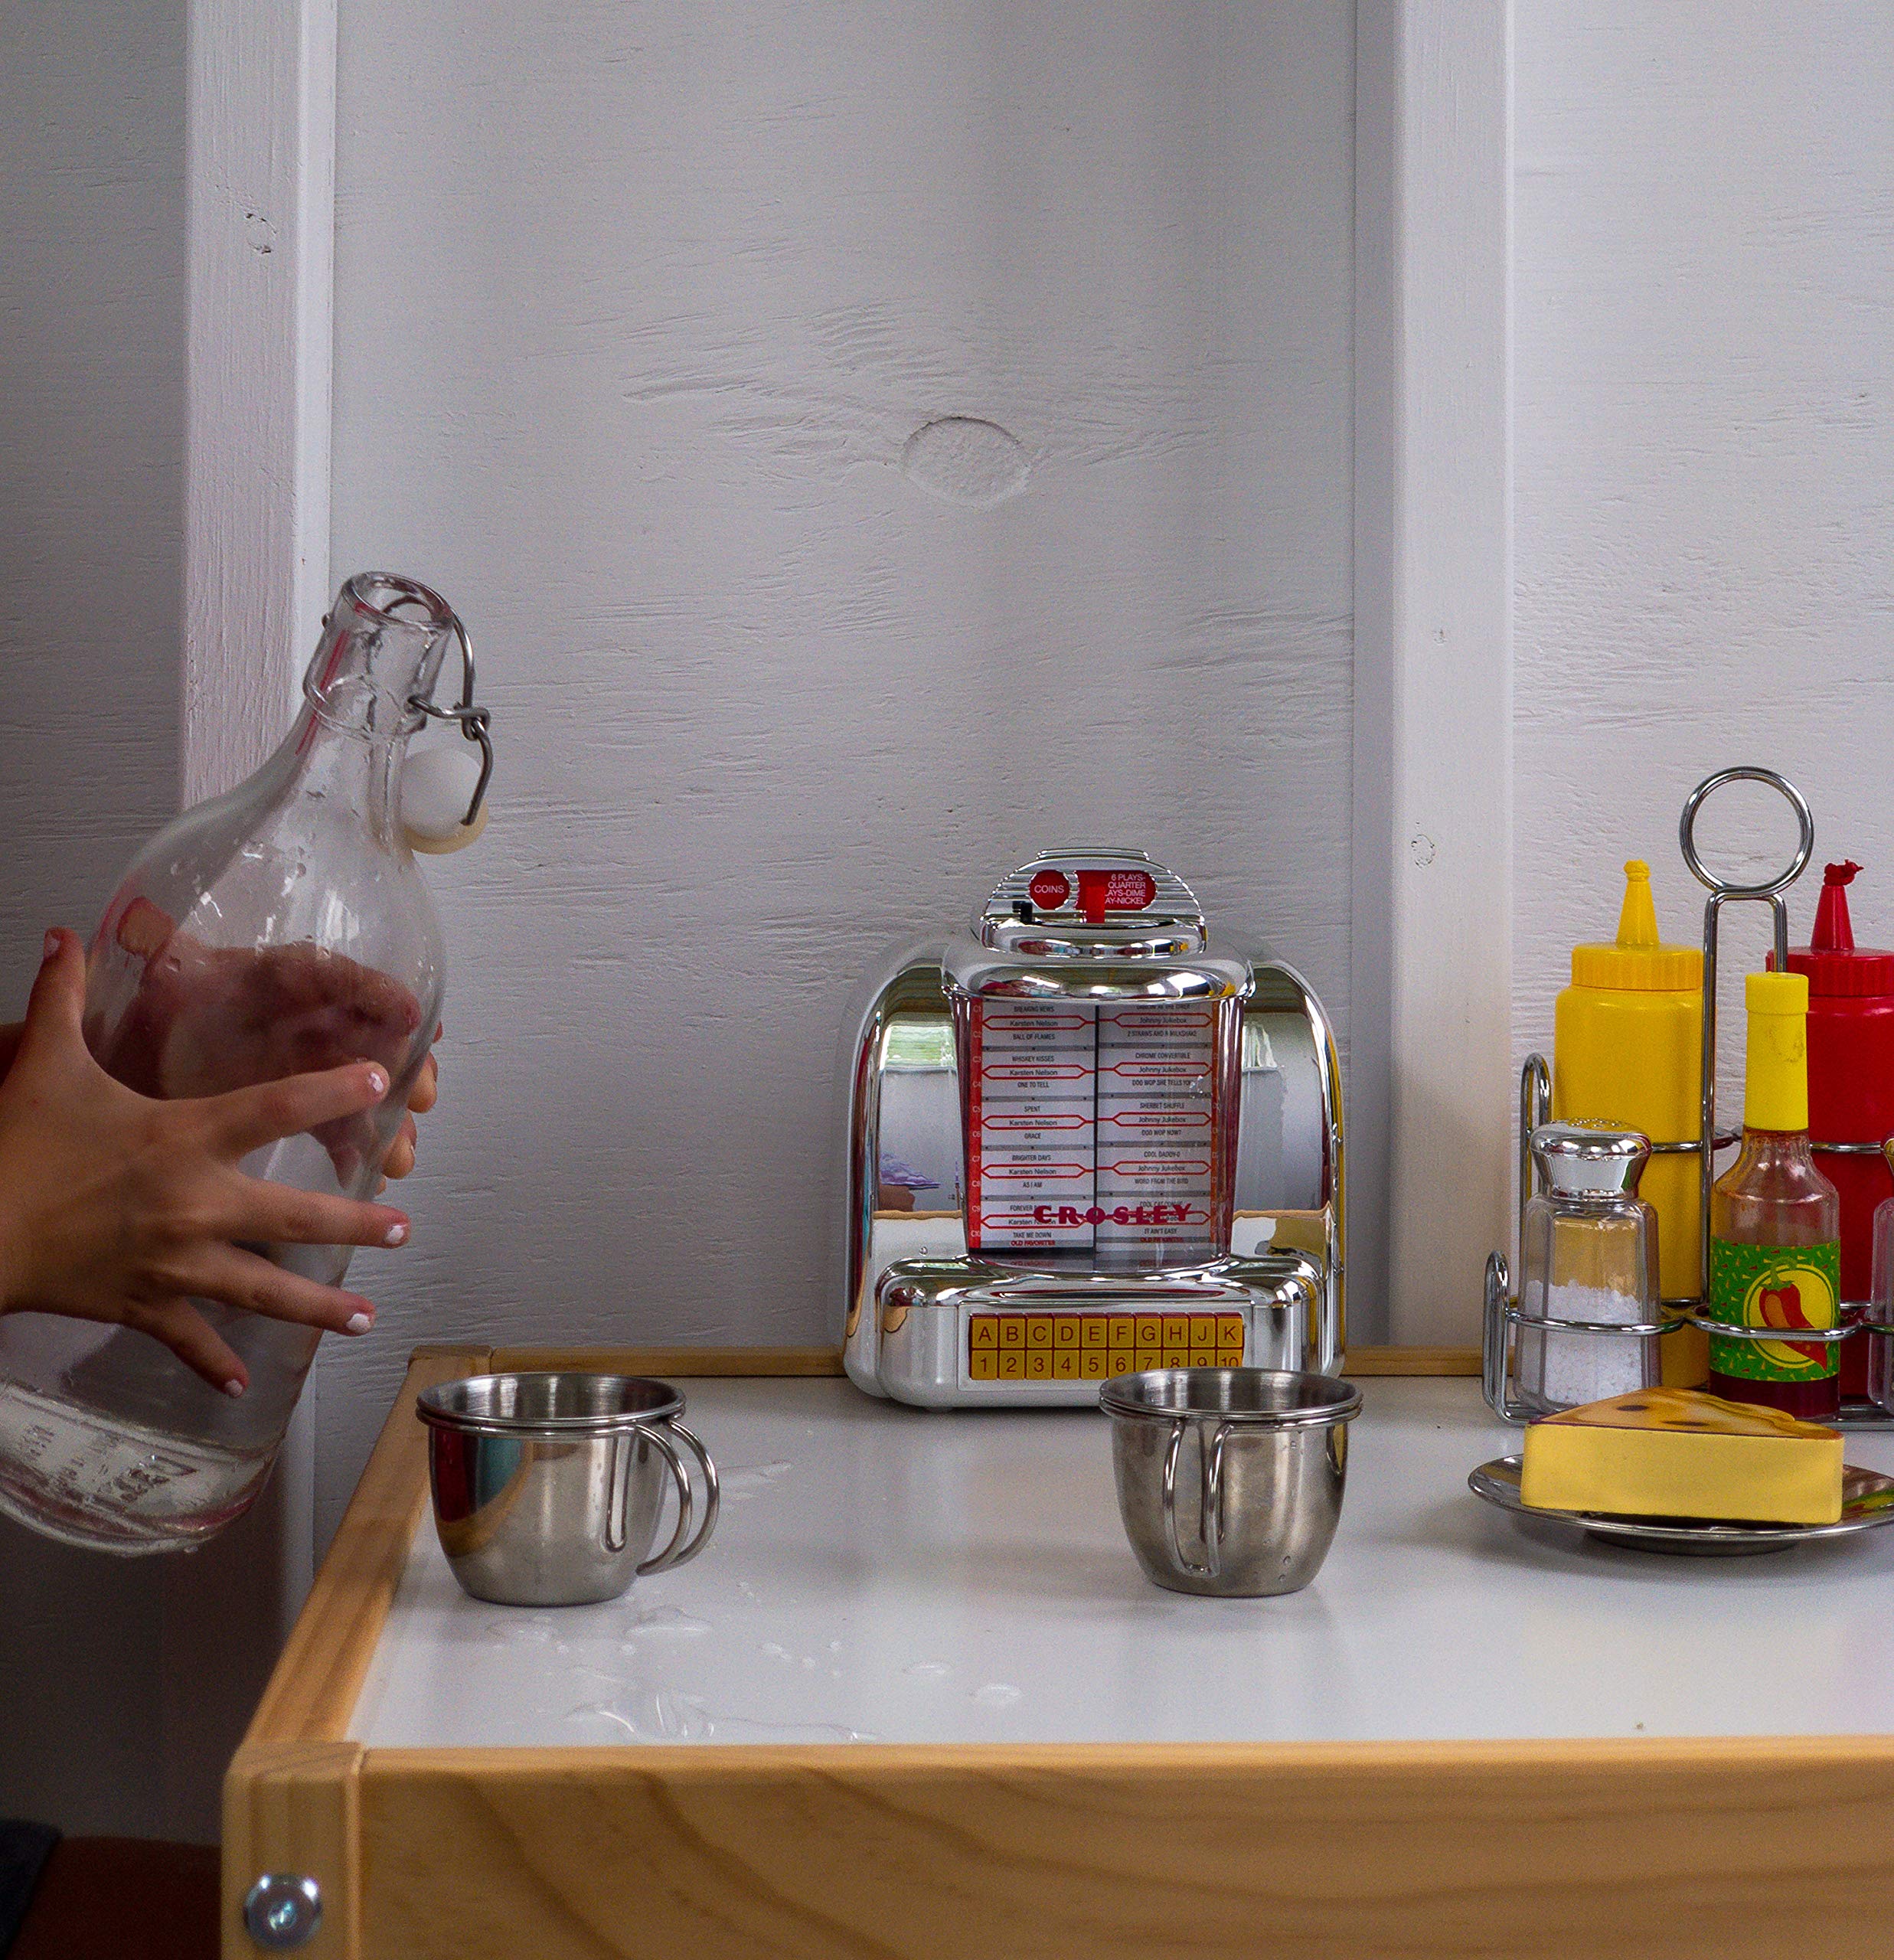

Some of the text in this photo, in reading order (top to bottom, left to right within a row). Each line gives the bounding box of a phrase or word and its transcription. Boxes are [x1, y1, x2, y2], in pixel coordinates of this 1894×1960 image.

[1034, 1203, 1192, 1225] CROSLEY
[978, 1326, 1236, 1341] A B C D E F G H J K
[981, 1357, 987, 1372] 1
[1006, 1357, 1017, 1372] 2
[1034, 1357, 1044, 1372] 3
[1061, 1357, 1071, 1372] 4
[1089, 1357, 1099, 1372] 5
[1116, 1357, 1126, 1372] 6
[1143, 1357, 1153, 1371] 7
